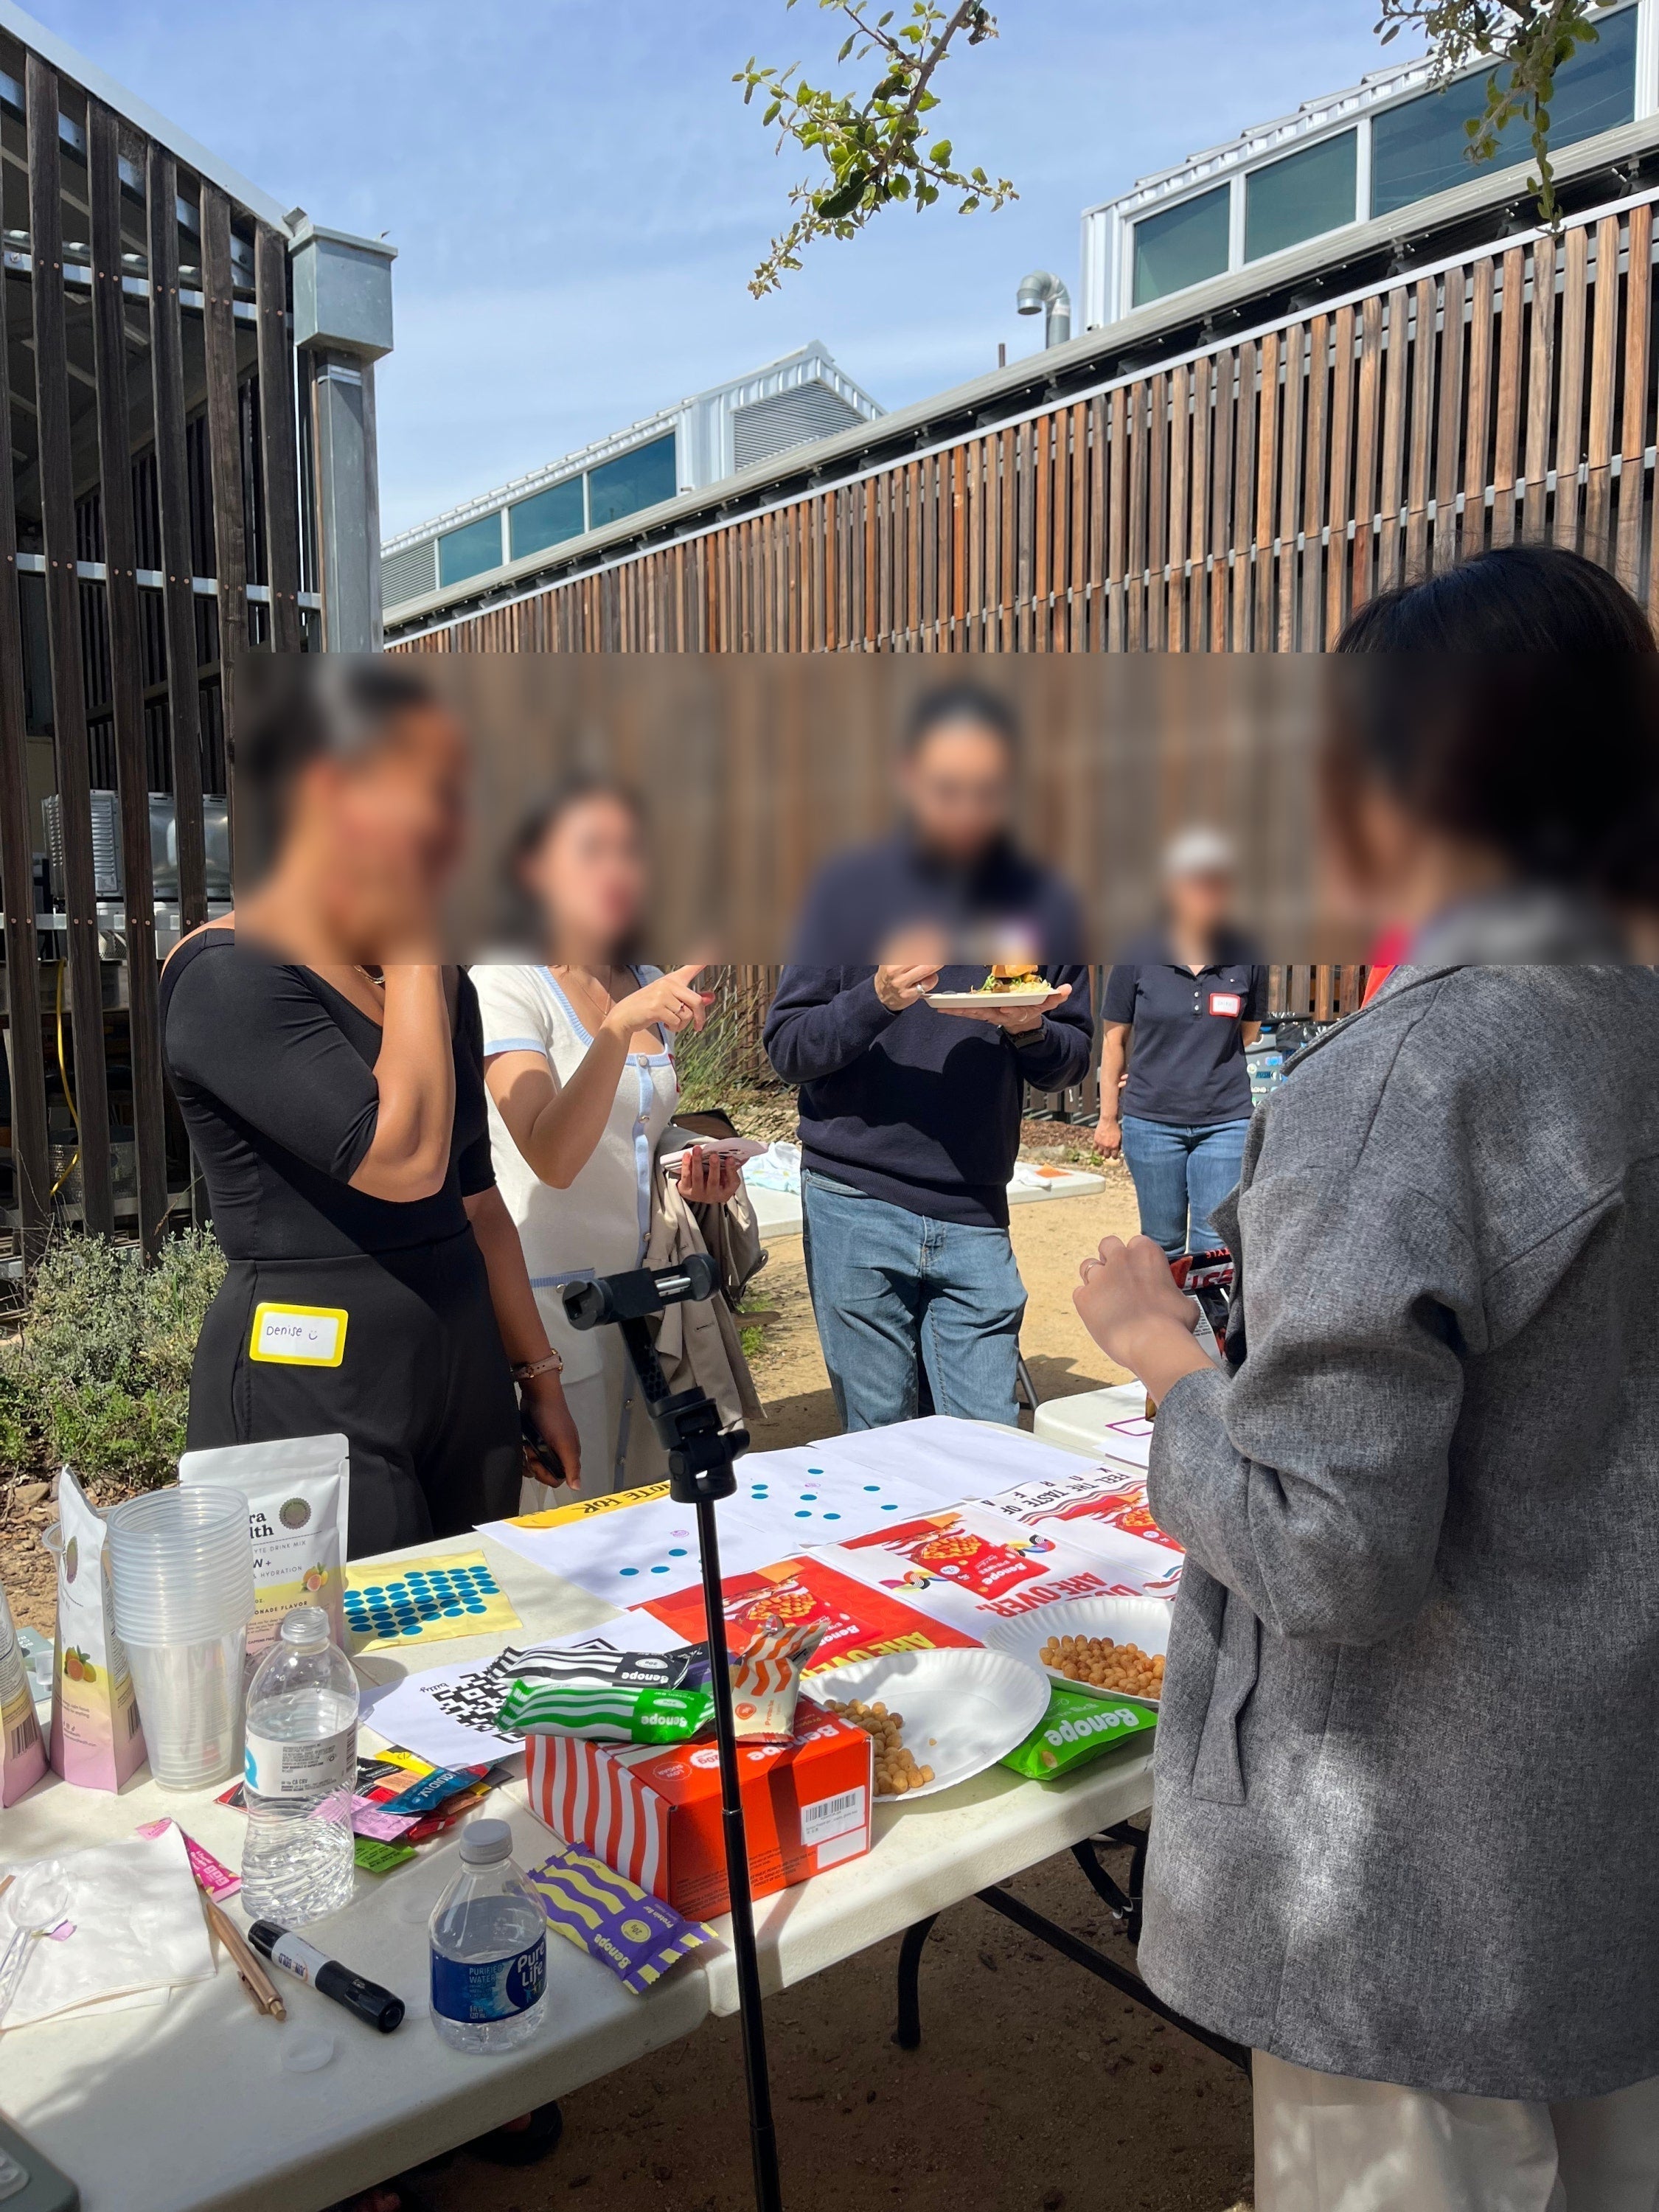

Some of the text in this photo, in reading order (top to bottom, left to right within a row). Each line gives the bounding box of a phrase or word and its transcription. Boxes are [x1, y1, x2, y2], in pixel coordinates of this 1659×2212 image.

[266, 1325, 302, 1337] Denise
[1000, 1472, 1133, 1515] FEEL THE TASTE OF
[577, 1498, 623, 1514] FOR
[270, 1543, 291, 1552] DRINK
[260, 1565, 302, 1579] HYDRATION
[1045, 1572, 1107, 1595] ARE
[281, 1600, 308, 1613] FLAVOR
[975, 1586, 1062, 1618] OVER.
[621, 1671, 669, 1685] Benope
[640, 1713, 688, 1728] Benope
[1043, 1708, 1140, 1747] Benope
[658, 1764, 684, 1775] SUGAR
[666, 1769, 685, 1778] LOW
[642, 1905, 655, 1915] Bar
[652, 1910, 675, 1929] Protein
[630, 1924, 643, 1935] 20g
[517, 1941, 546, 1973] Pure
[594, 1933, 632, 1969] Benope
[469, 1964, 503, 1976] PURIFIED
[521, 1960, 543, 1987] Life
[469, 1974, 496, 1984] WATER
